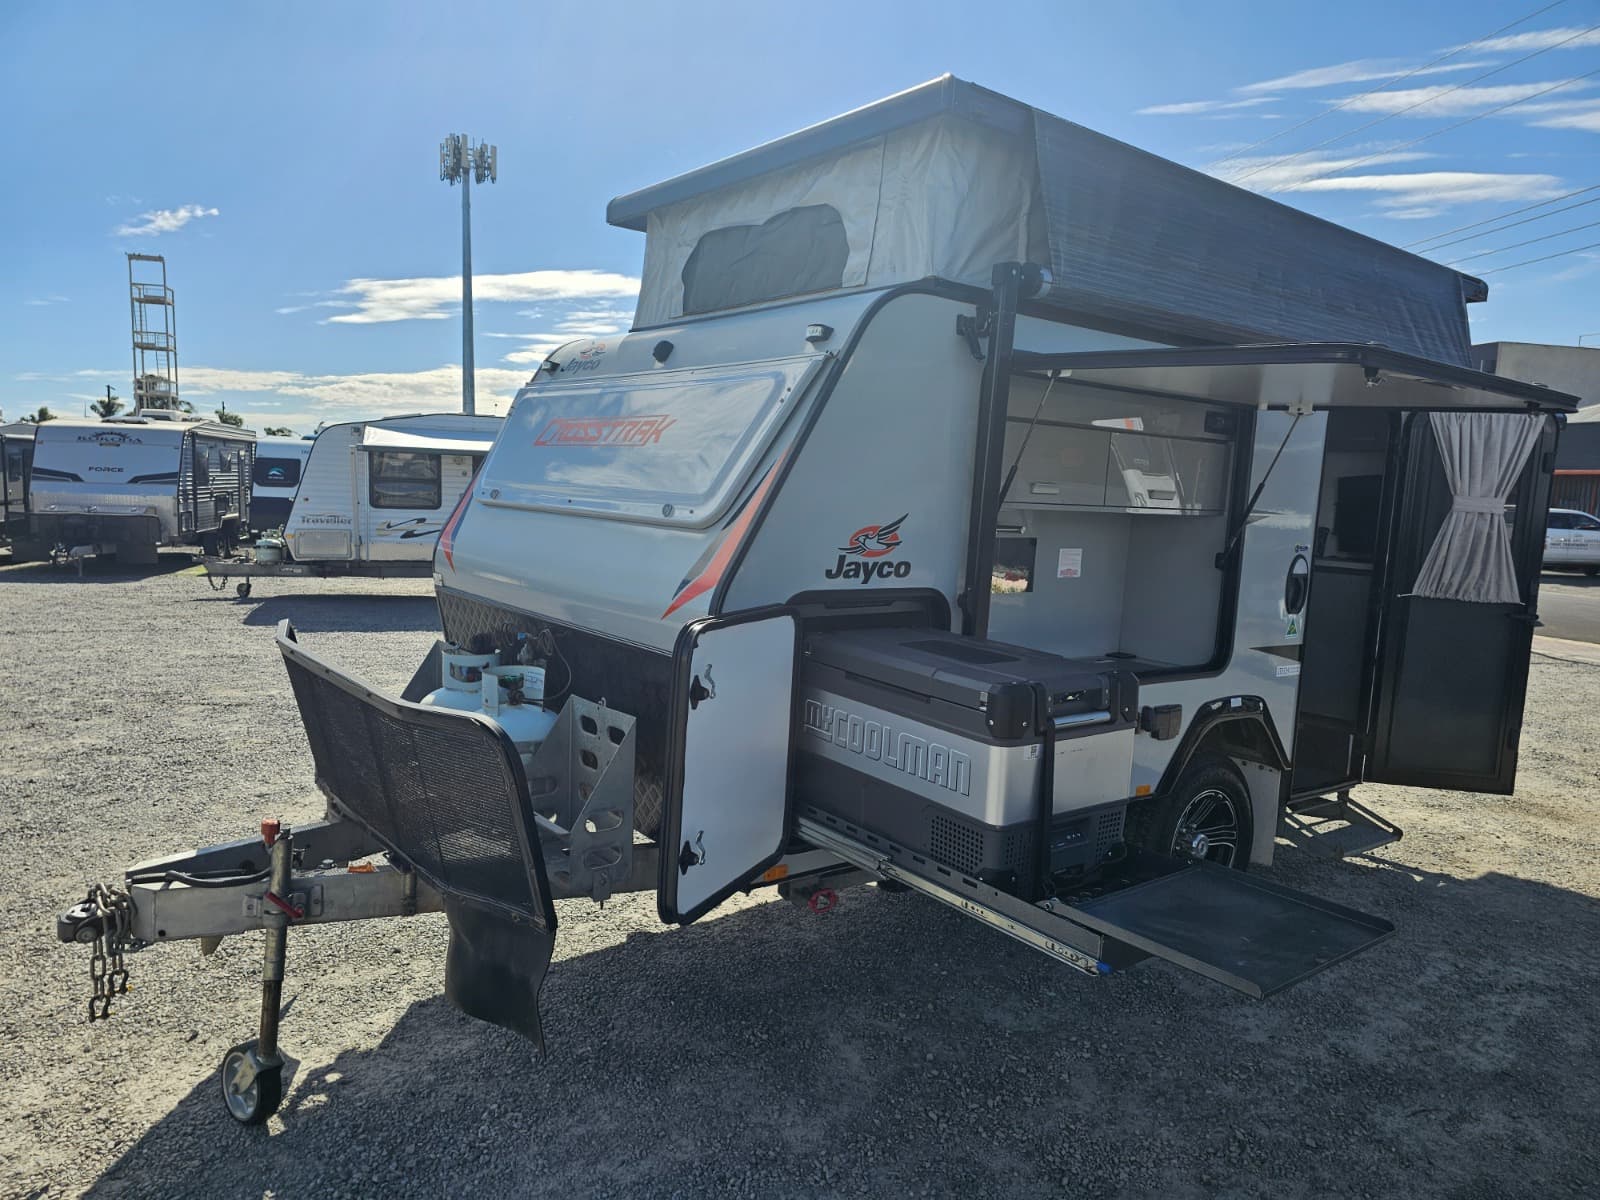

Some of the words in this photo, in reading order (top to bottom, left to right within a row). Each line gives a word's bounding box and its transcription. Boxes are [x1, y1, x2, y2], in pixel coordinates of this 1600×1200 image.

[559, 357, 602, 375] Jayco
[533, 414, 678, 447] CROSSTRAK
[825, 554, 912, 585] Jayco
